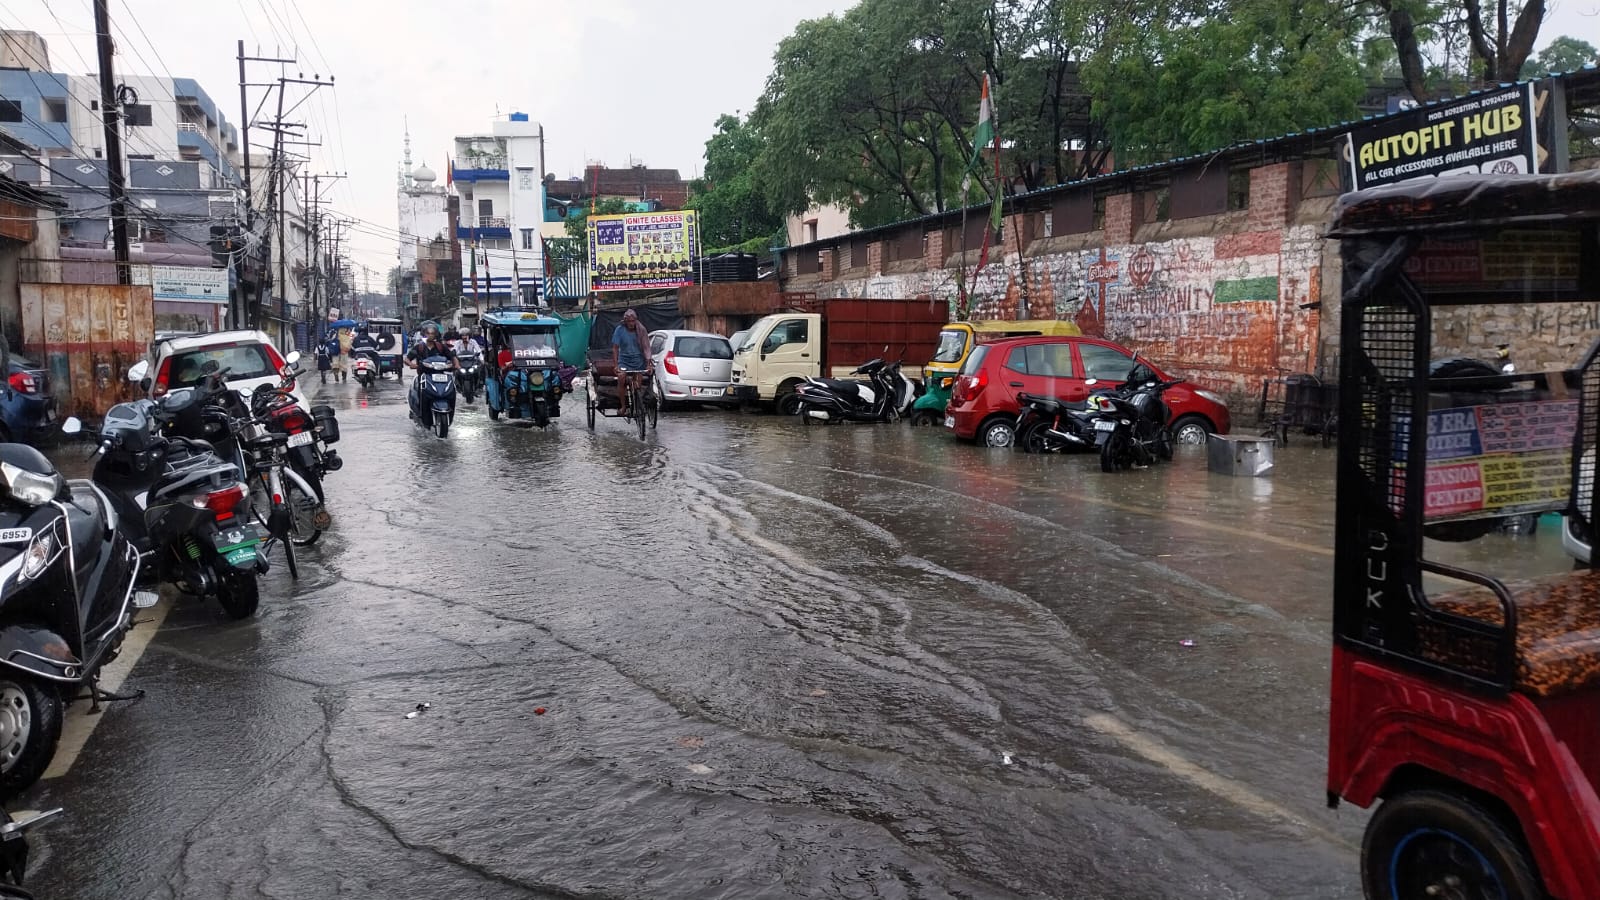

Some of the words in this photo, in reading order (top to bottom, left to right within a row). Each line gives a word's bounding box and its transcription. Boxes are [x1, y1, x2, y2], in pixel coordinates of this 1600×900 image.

[1359, 121, 1454, 169] AUTOFIT
[1464, 105, 1522, 144] HUB
[1365, 172, 1378, 183] ALL
[1378, 166, 1394, 178] CAR
[1394, 155, 1444, 176] ACCESSORIES
[1444, 144, 1491, 165] AVAILABLE
[1492, 138, 1518, 154] HERE
[626, 217, 648, 225] IGNITE
[651, 215, 683, 223] CLASSES
[1140, 285, 1215, 314] HUMANITY
[1442, 412, 1476, 432] ERA
[1430, 487, 1481, 506] CENTER
